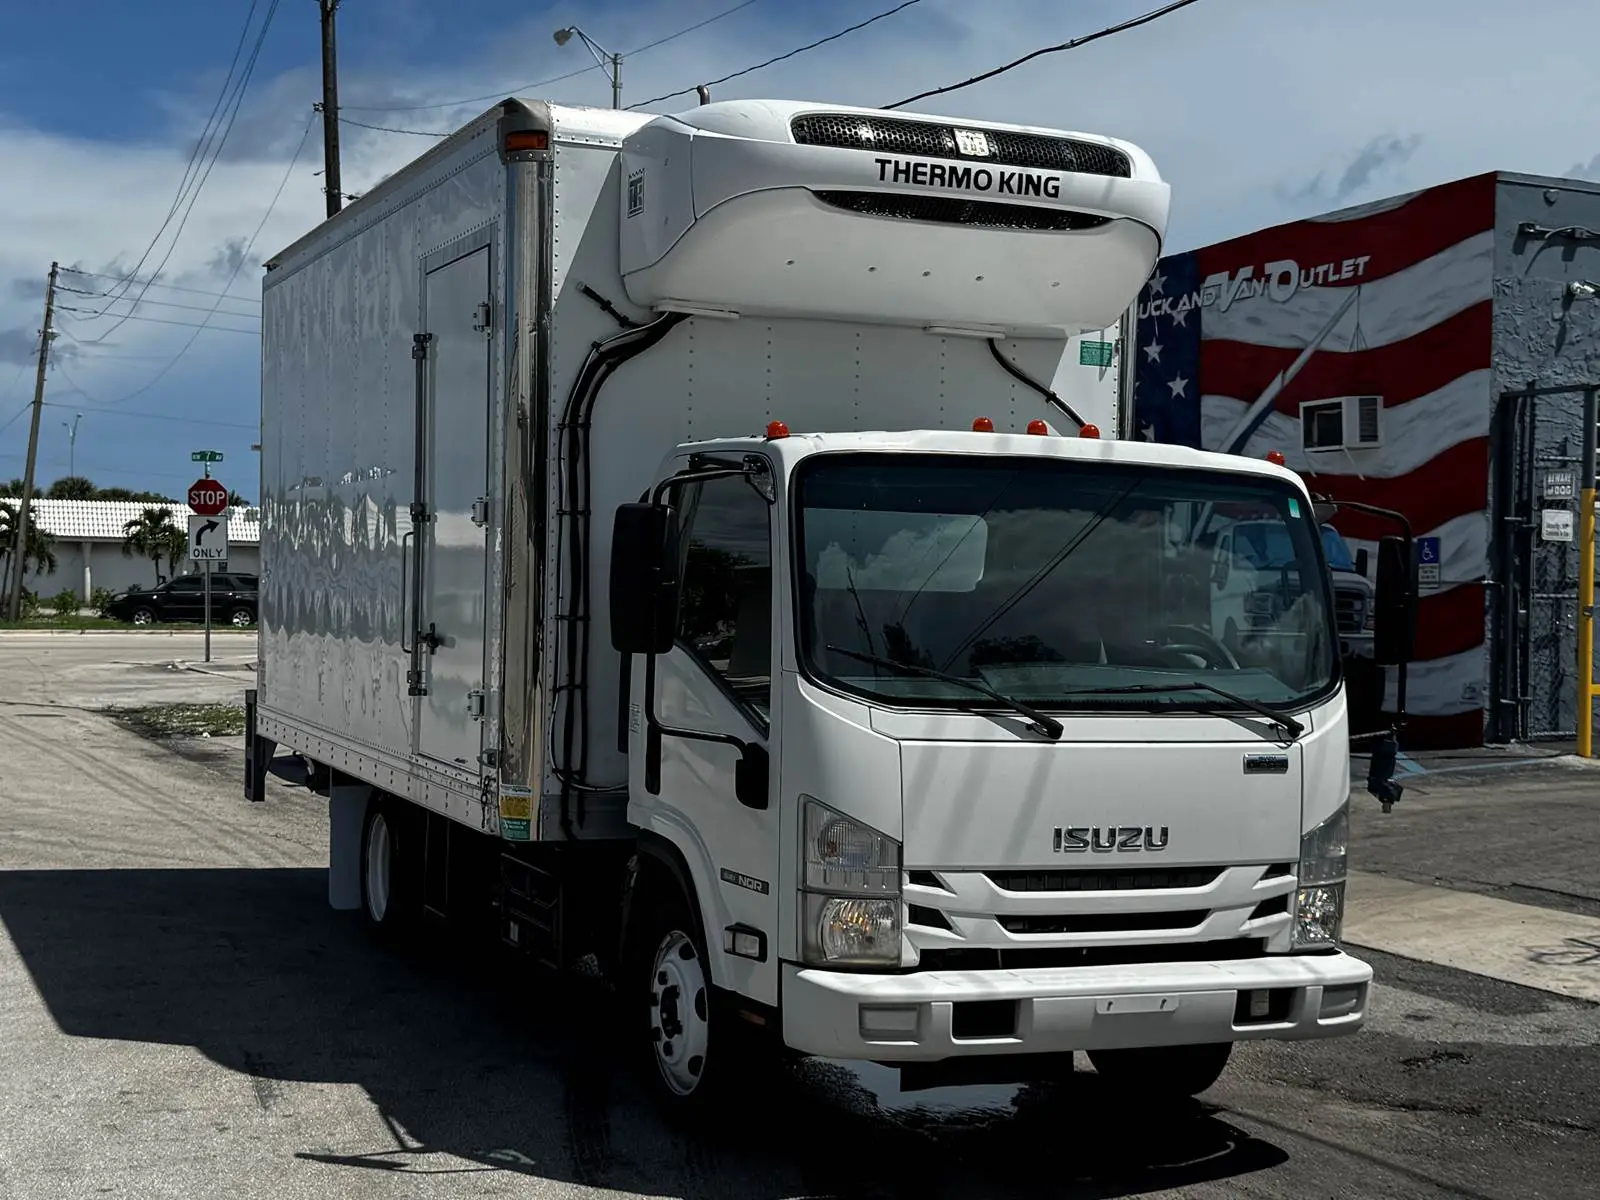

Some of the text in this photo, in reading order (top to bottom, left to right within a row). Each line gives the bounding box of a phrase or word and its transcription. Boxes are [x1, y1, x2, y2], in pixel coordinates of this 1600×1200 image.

[875, 158, 1061, 199] THERMO KING
[1138, 297, 1174, 320] UCK
[1264, 255, 1371, 304] OUTLET
[190, 490, 226, 506] STOP
[193, 548, 223, 558] ONLY
[1053, 825, 1169, 853] ISUZU
